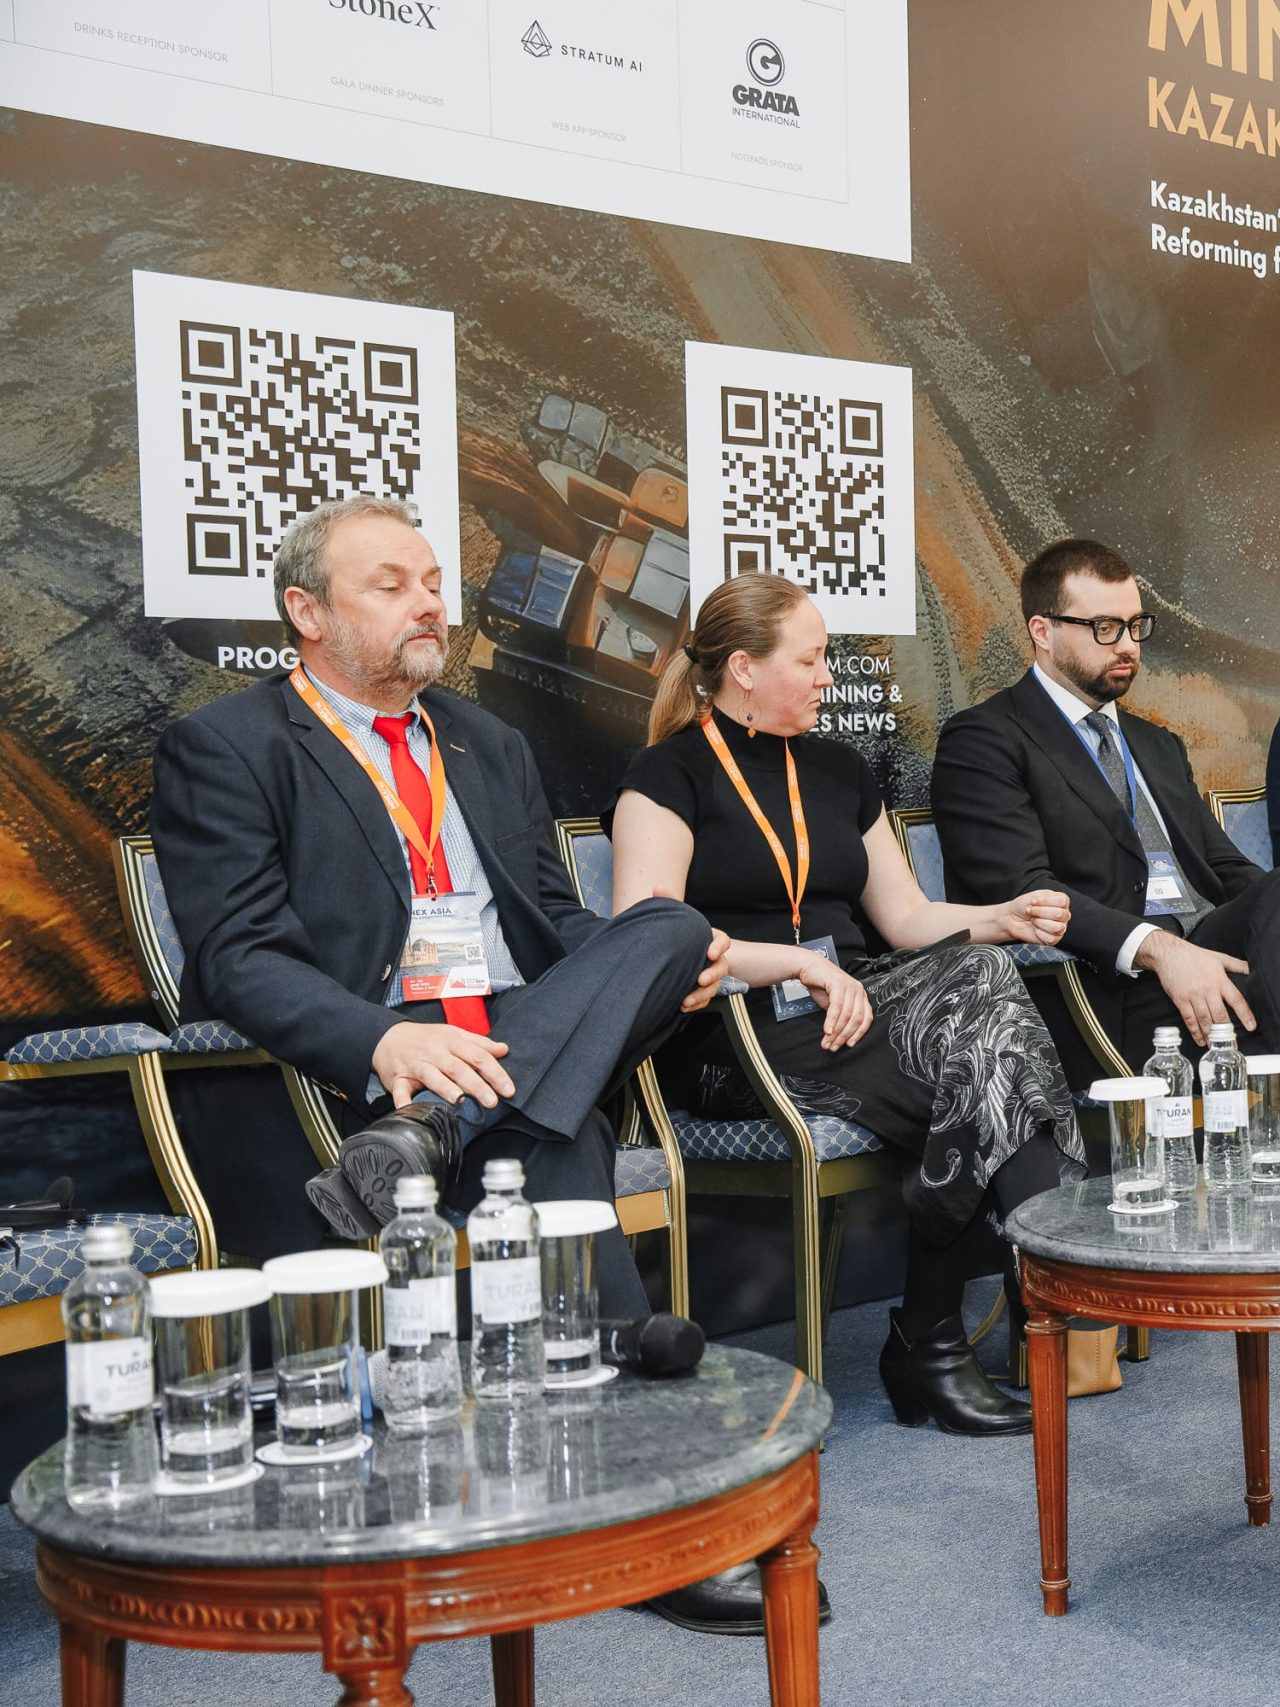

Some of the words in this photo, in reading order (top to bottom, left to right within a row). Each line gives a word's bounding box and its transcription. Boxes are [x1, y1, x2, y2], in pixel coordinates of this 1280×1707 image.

[74, 22, 114, 39] DRINKS
[117, 31, 175, 52] RECEPTION
[178, 44, 228, 63] SPONSOR
[561, 45, 624, 68] STRATUM
[630, 60, 642, 72] AI
[330, 76, 356, 89] GALA
[359, 81, 394, 97] DINNER
[396, 89, 445, 107] SPONSORS
[732, 84, 800, 116] GRATA
[732, 107, 801, 129] INTERNATIONAL
[1150, 222, 1268, 280] Reforming
[217, 646, 300, 670] PROG
[826, 656, 890, 674] M.COM
[889, 684, 903, 703] &
[838, 713, 897, 732] NEWS
[430, 907, 452, 916] ASIA
